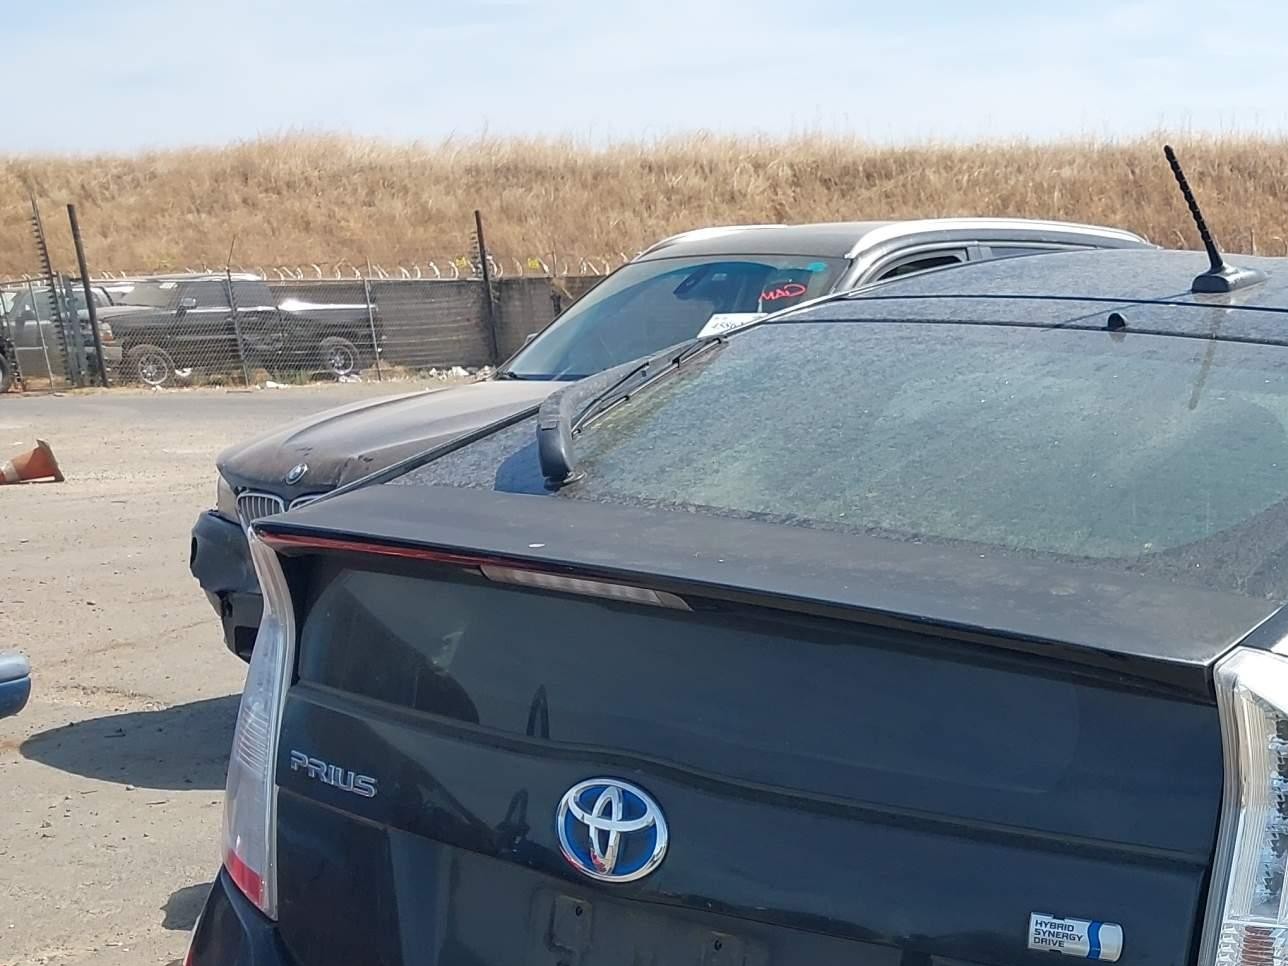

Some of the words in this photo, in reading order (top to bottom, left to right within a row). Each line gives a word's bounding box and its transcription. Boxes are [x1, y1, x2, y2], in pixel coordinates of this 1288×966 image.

[291, 750, 377, 798] PRIUS
[1034, 919, 1075, 932] HYBRID
[1034, 928, 1083, 942] SYNERGY
[1033, 936, 1065, 948] DRIVE
